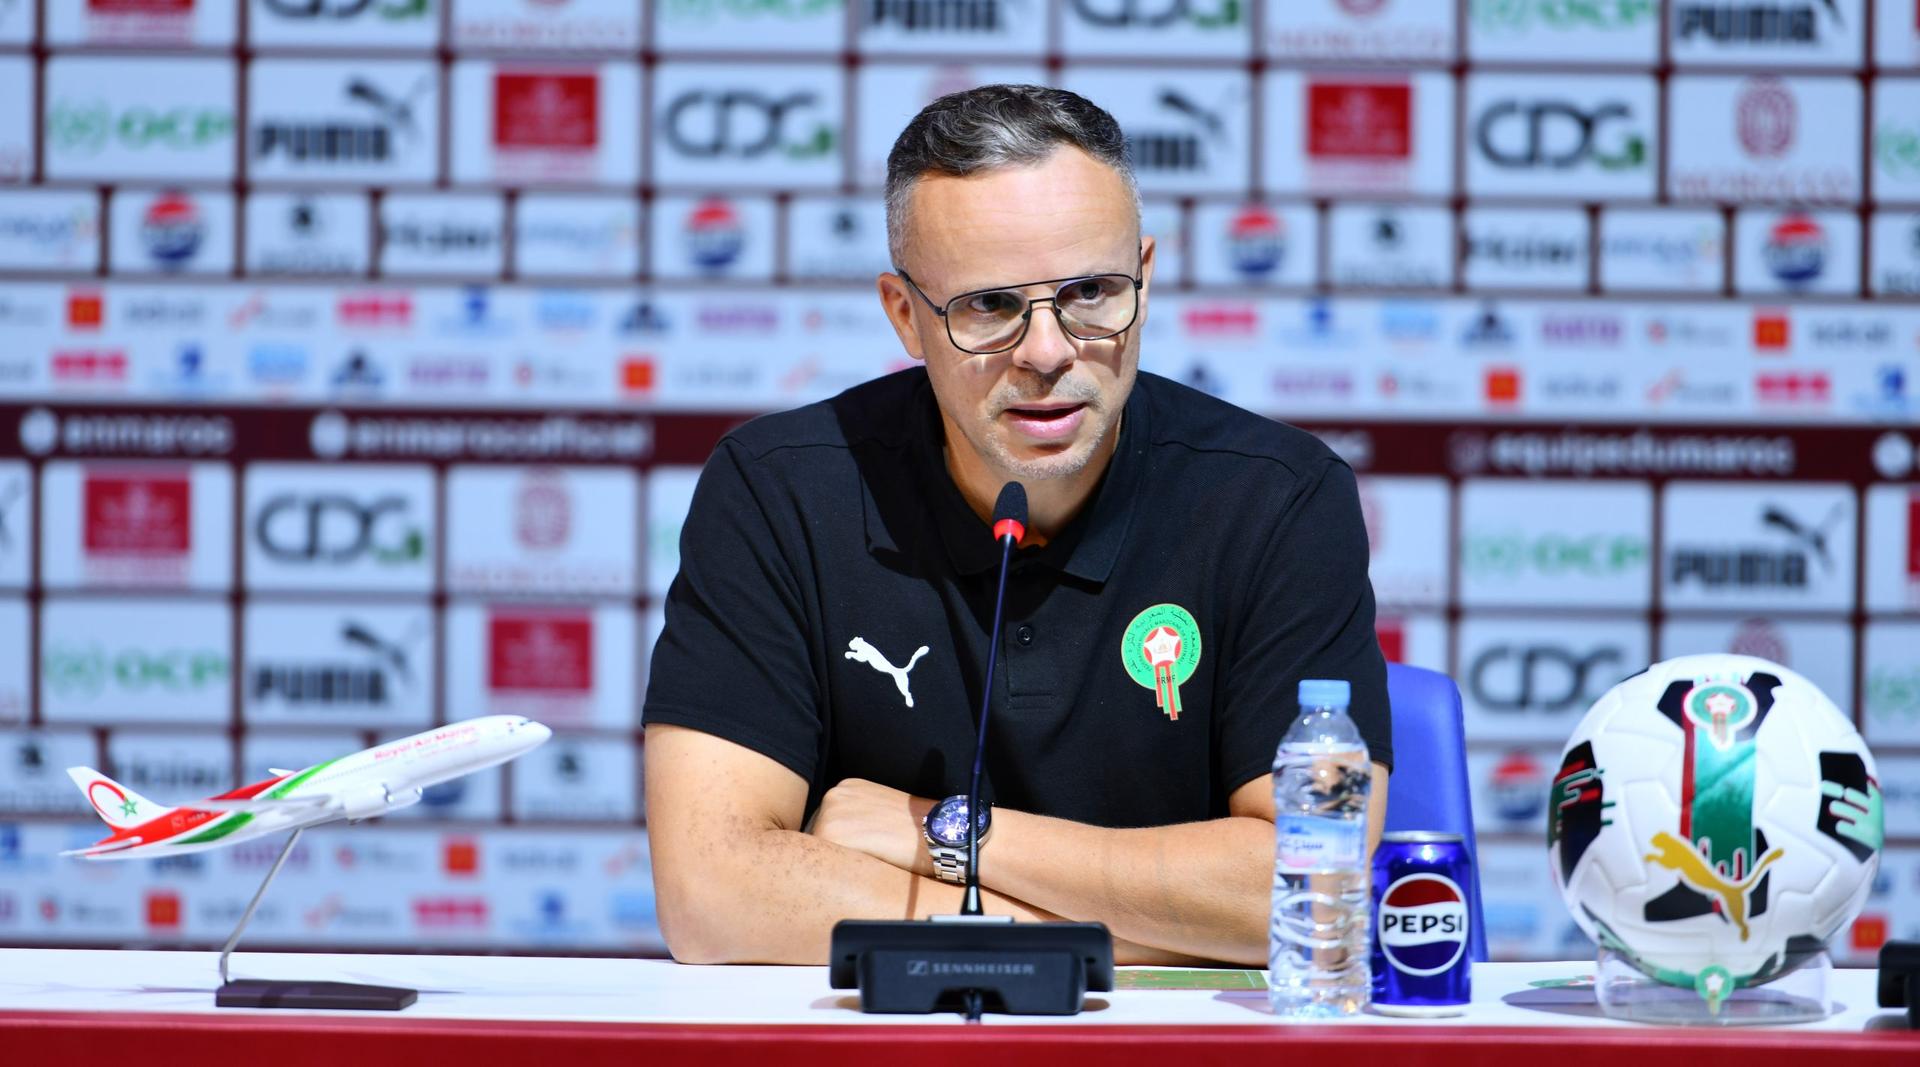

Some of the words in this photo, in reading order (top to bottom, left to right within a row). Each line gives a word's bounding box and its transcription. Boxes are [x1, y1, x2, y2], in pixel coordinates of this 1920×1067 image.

[1678, 5, 1818, 42] PUMA
[257, 121, 392, 162] PUMA
[1672, 551, 1808, 588] PUMA
[252, 665, 388, 704] PUMA
[1384, 914, 1463, 933] PEPSI
[932, 962, 1035, 975] SENNHEISER
